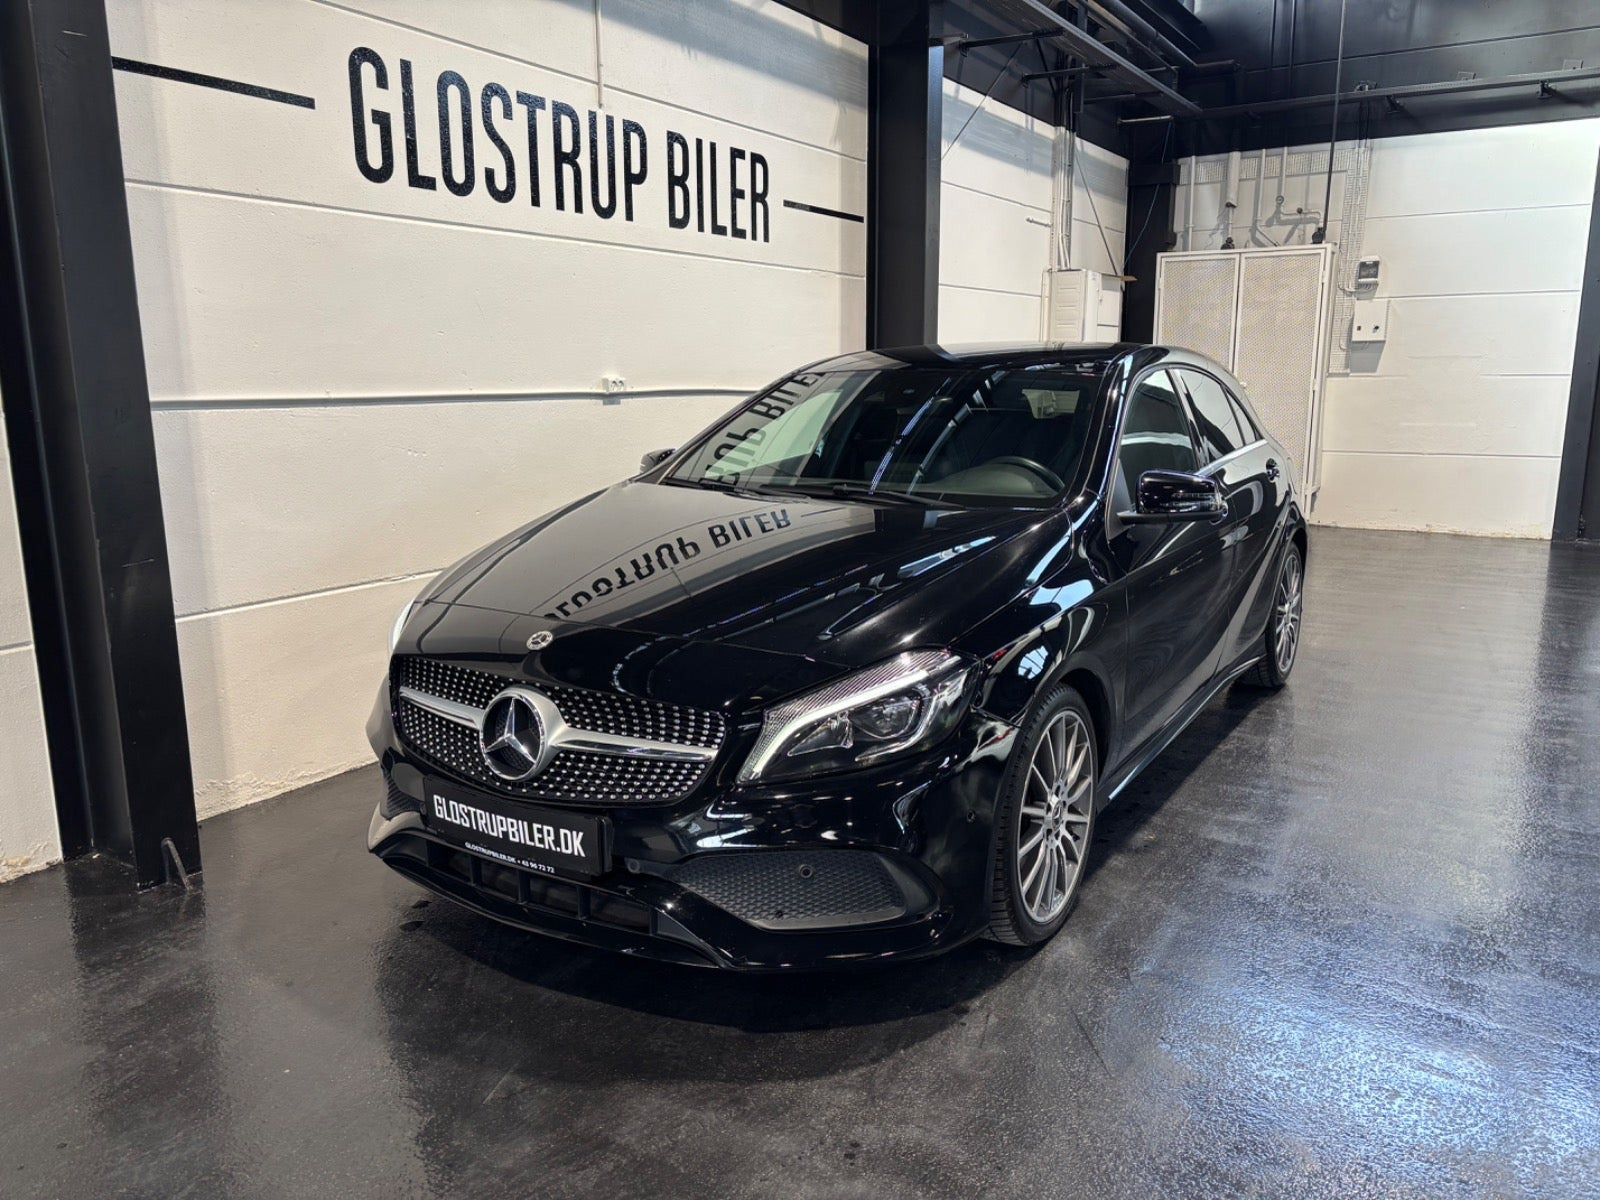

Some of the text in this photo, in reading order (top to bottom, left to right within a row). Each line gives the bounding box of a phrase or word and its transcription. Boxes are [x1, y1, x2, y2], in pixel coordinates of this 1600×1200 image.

[348, 46, 770, 243] GLOSTRUP BILER
[433, 794, 586, 857] GLOSTRUPBILER.DK
[464, 841, 516, 864] GLOSTRUPBILER.DK
